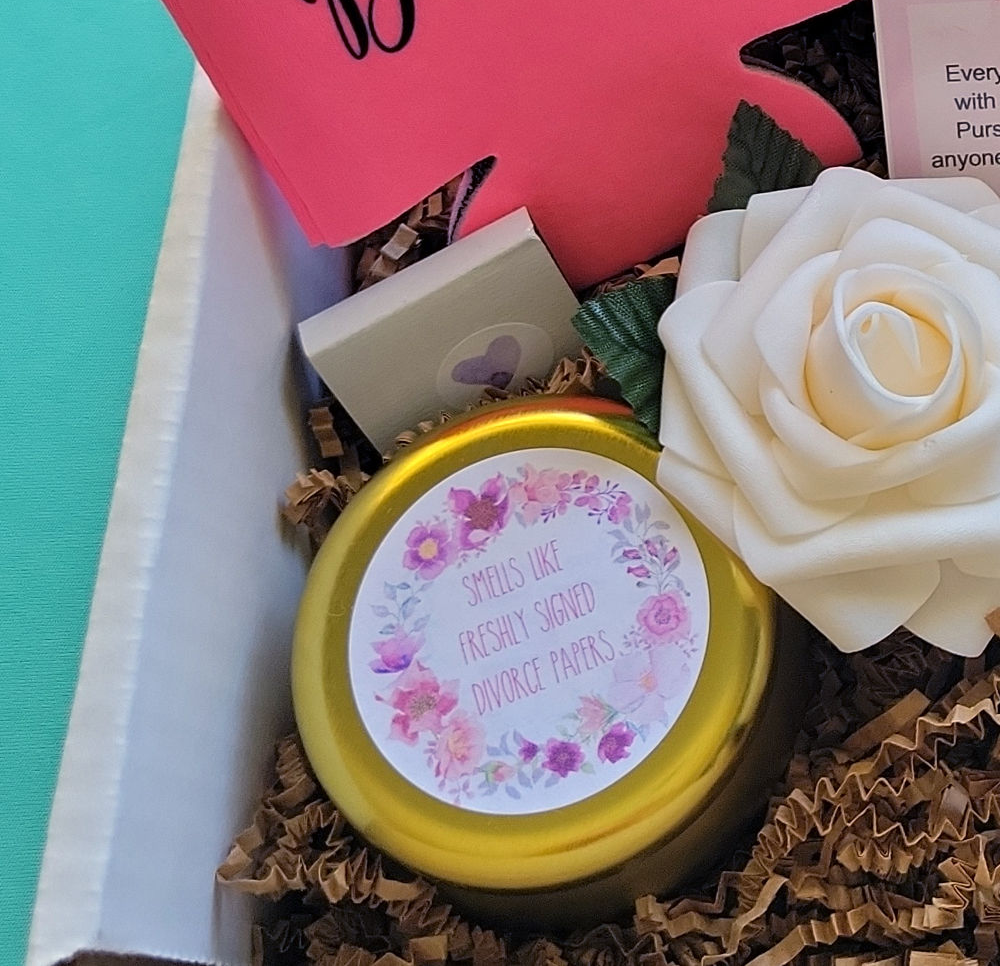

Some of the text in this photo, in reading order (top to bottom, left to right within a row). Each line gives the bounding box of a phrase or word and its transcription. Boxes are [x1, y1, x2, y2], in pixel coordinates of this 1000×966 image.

[954, 93, 995, 110] with
[462, 539, 563, 607] SMELLS LIKE
[458, 582, 596, 665] FRESHLY SIGNED
[472, 630, 615, 716] DIVORCE PAPERS
